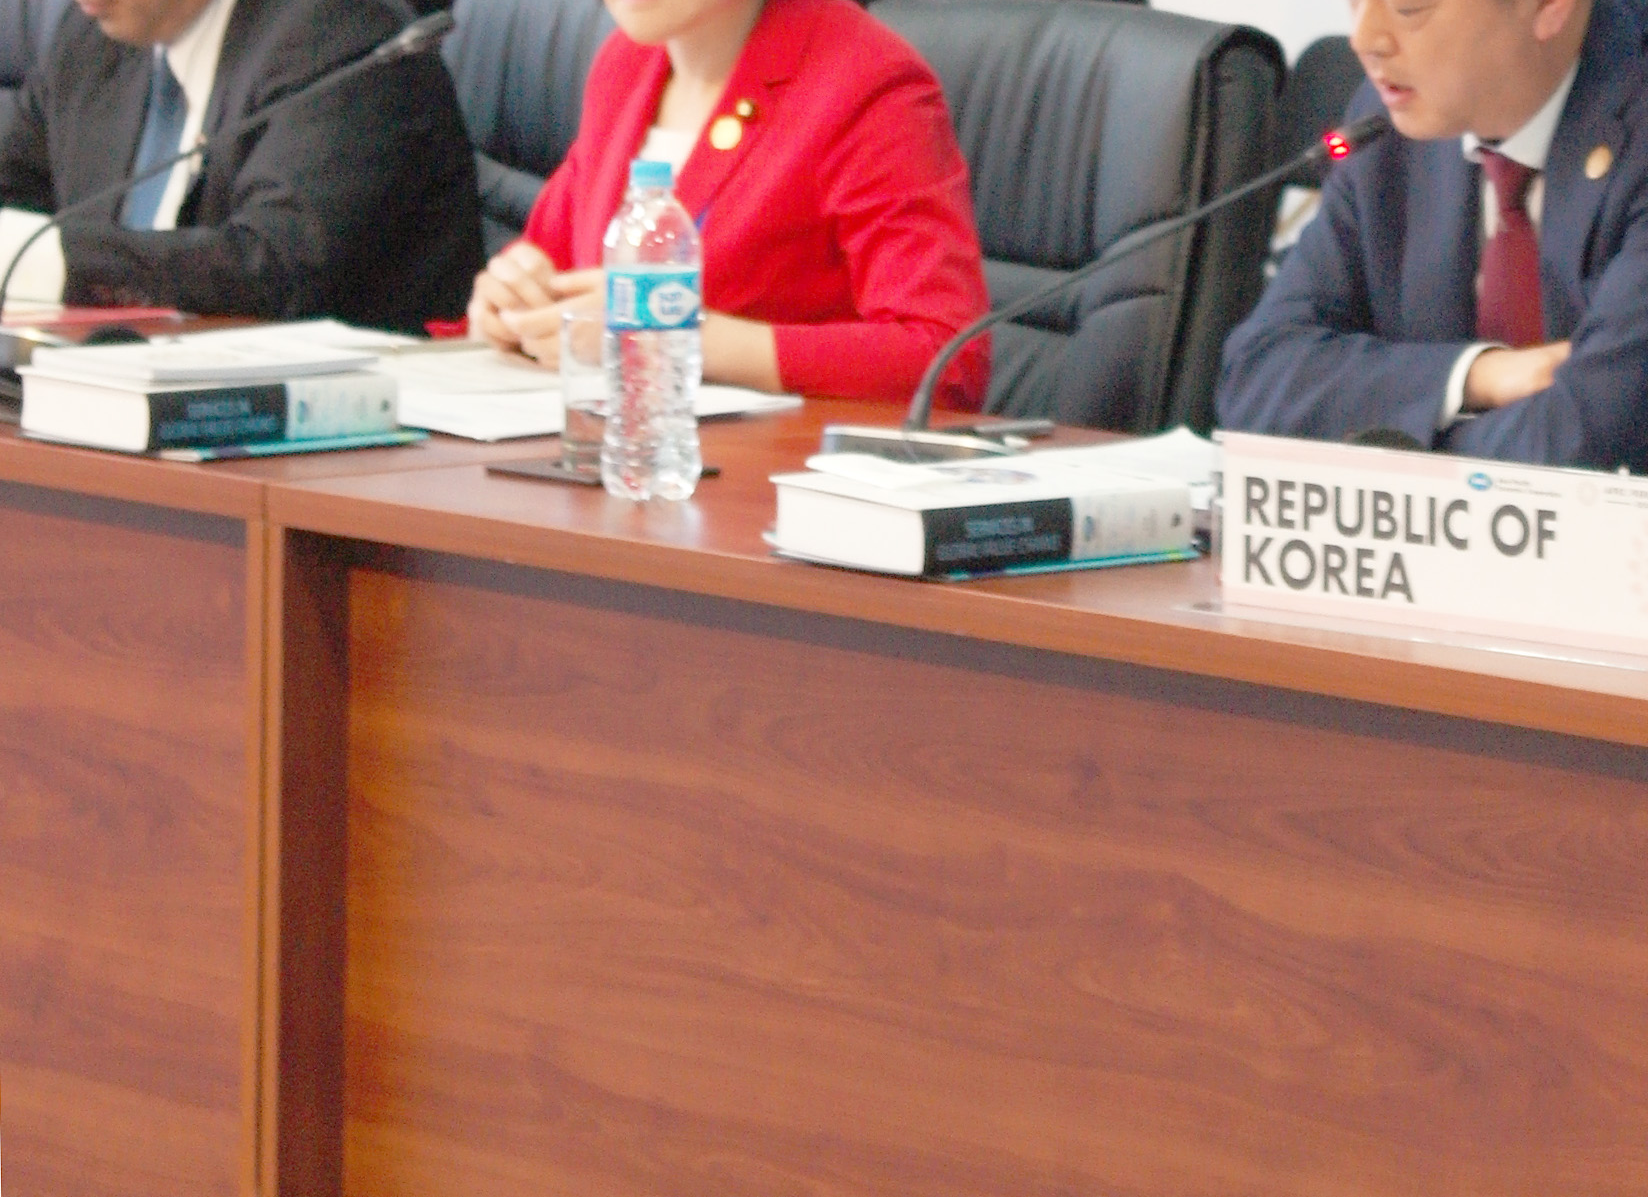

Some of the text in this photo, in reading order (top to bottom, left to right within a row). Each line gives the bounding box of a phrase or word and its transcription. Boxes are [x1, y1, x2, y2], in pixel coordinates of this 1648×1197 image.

[1245, 476, 1557, 558] REPUBLIC OF
[1244, 535, 1414, 603] KOREA
